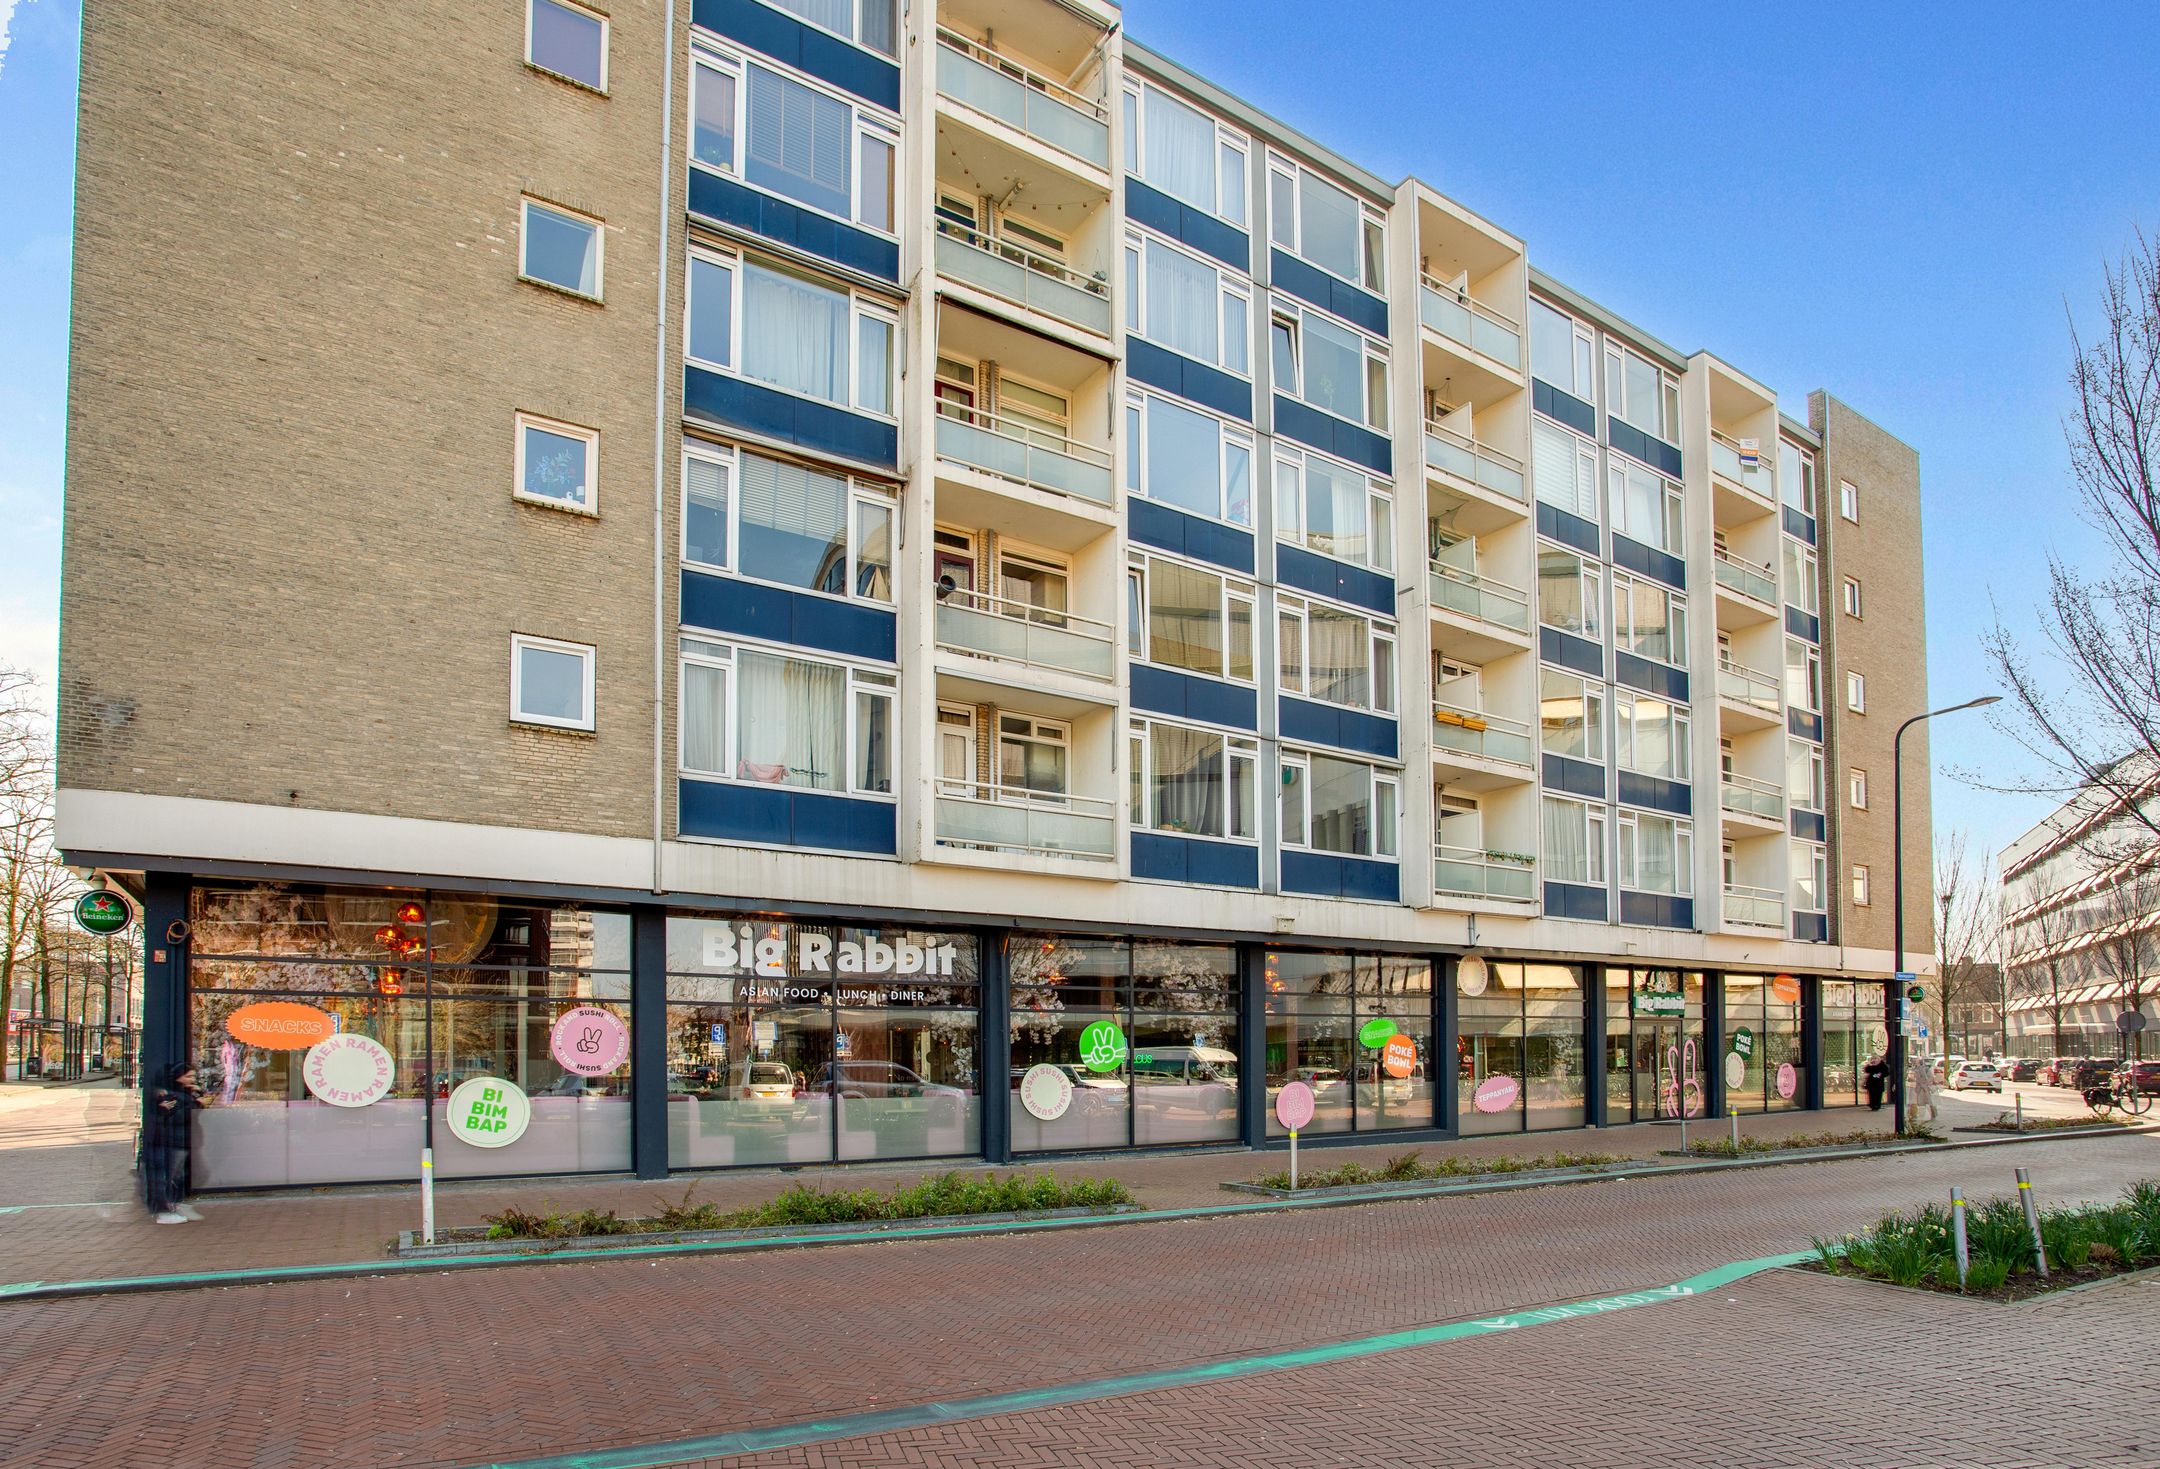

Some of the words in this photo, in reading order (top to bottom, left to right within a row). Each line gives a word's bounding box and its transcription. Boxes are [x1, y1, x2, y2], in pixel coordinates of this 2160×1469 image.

[82, 912, 124, 920] Heineken
[702, 925, 787, 978] Big
[799, 932, 957, 975] Rabbit
[740, 986, 779, 998] ASIAN
[783, 987, 819, 998] FOOD
[837, 990, 877, 1000] LUNCH
[891, 990, 925, 1001] DINER
[1823, 984, 1845, 1007] Big
[1846, 985, 1885, 1005] Rabbit
[1636, 995, 1654, 1011] Big
[240, 1018, 322, 1034] SNACKS
[556, 1024, 565, 1046] ROCK
[563, 1012, 578, 1025] AND
[579, 1010, 604, 1018] SUSHI
[604, 1014, 621, 1031] ROLL
[346, 1037, 388, 1076] RAMEN
[1389, 1043, 1413, 1058] POKÉ
[1735, 1042, 1751, 1055] BOWL
[311, 1039, 341, 1089] RAMEN
[559, 1050, 577, 1067] ROLL
[1387, 1055, 1411, 1069] BOWL
[1040, 1068, 1065, 1083] SUSHI
[327, 1079, 384, 1102] RAMEN
[1025, 1071, 1039, 1099] SUSHI
[1479, 1085, 1514, 1102] TEPPANYAKI
[483, 1088, 503, 1103] BI
[1055, 1085, 1067, 1112] SUSHI
[471, 1101, 508, 1119] BIM
[1028, 1100, 1053, 1115] SUSHI
[466, 1115, 507, 1133] BAP
